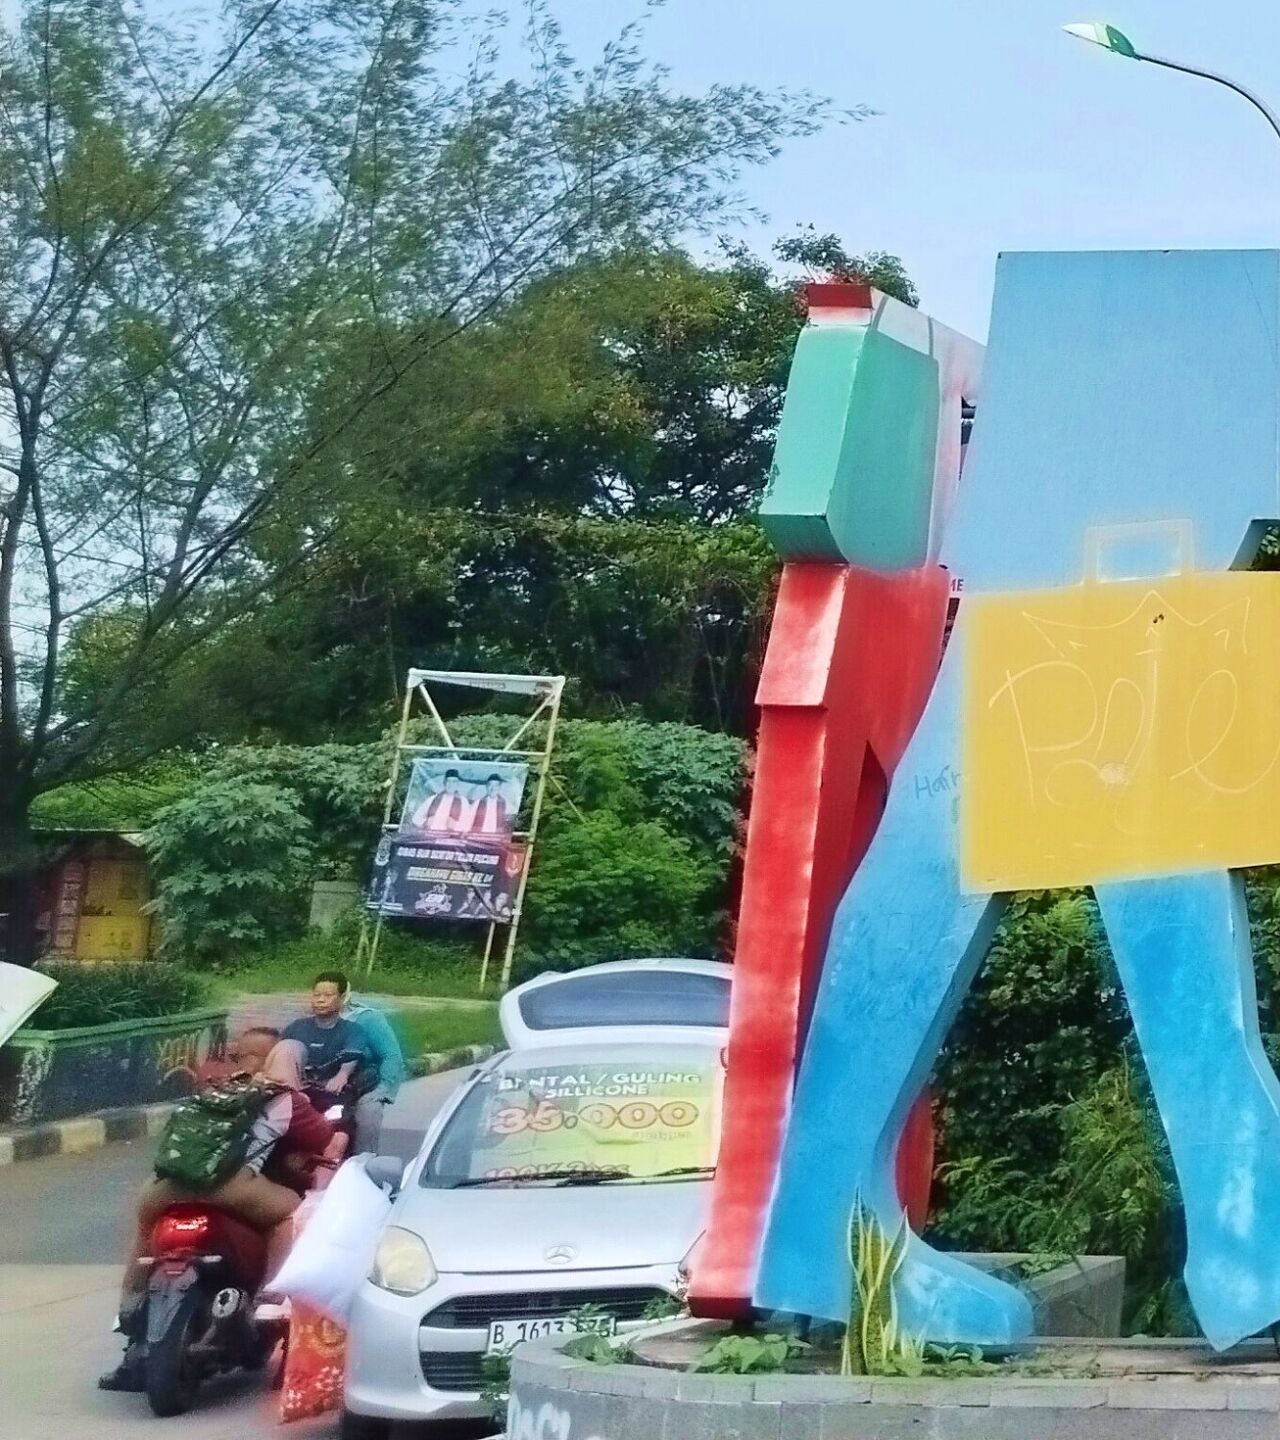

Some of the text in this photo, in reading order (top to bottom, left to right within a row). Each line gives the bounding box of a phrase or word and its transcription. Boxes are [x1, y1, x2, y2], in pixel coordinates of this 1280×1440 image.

[597, 1073, 609, 1085] /
[612, 1071, 701, 1084] GULING
[545, 1083, 649, 1099] SILLICONE
[491, 1101, 699, 1135] 35.000
[493, 1324, 504, 1344] B
